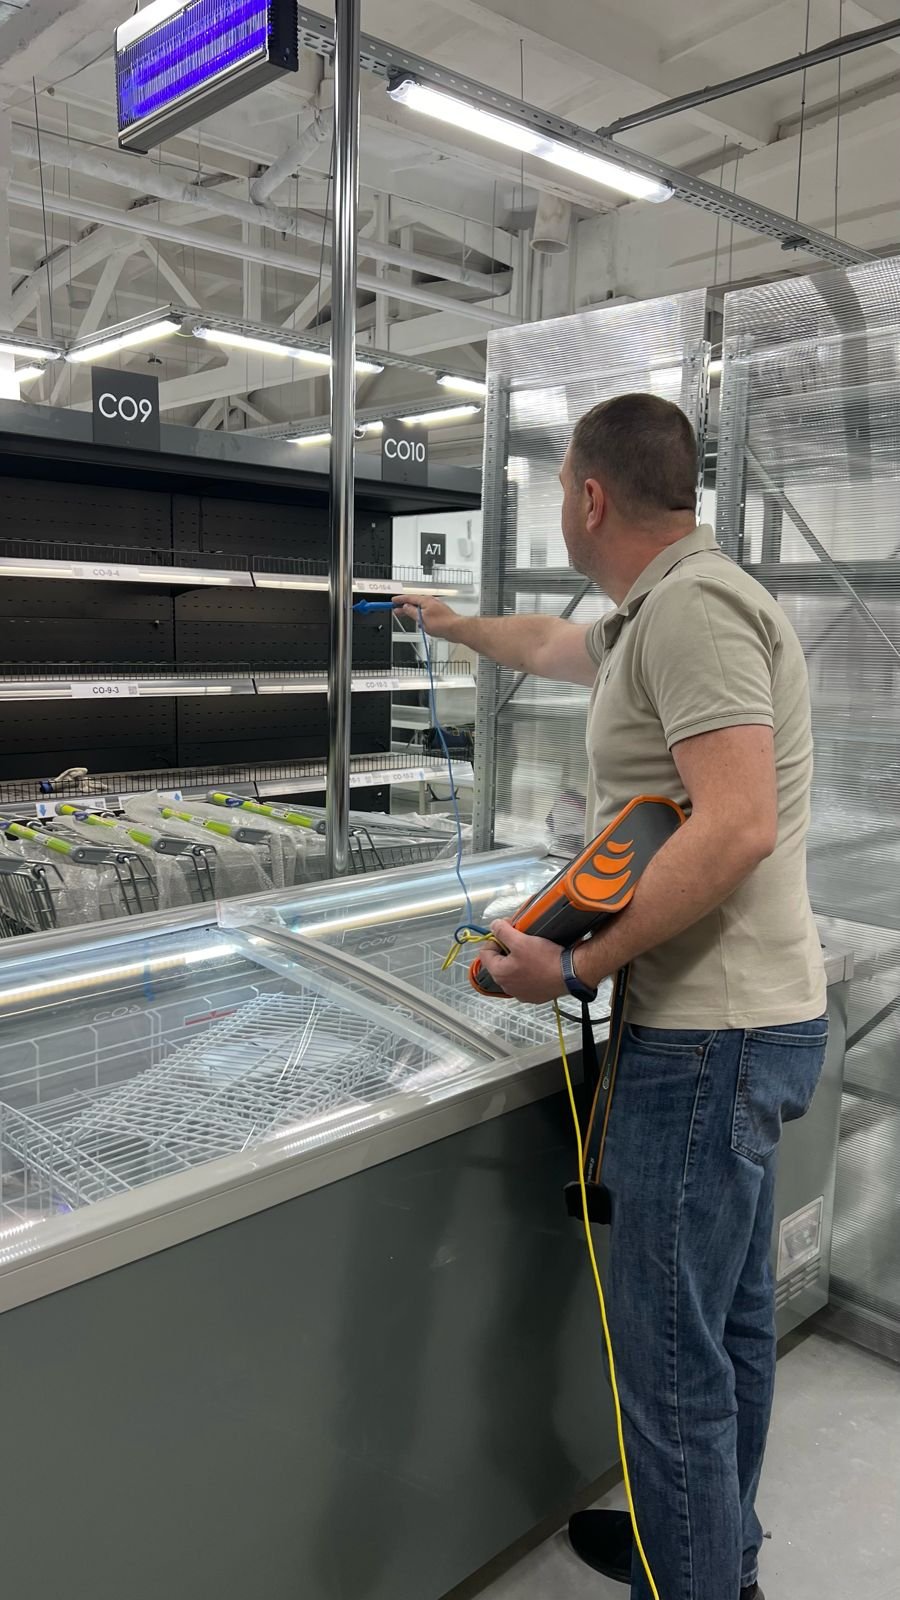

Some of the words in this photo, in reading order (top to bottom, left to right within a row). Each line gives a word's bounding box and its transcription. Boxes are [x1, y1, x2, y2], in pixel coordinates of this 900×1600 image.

[98, 392, 153, 423] CO9
[384, 438, 426, 462] CO10
[425, 543, 441, 556] A71
[92, 686, 120, 694] CO-9-3
